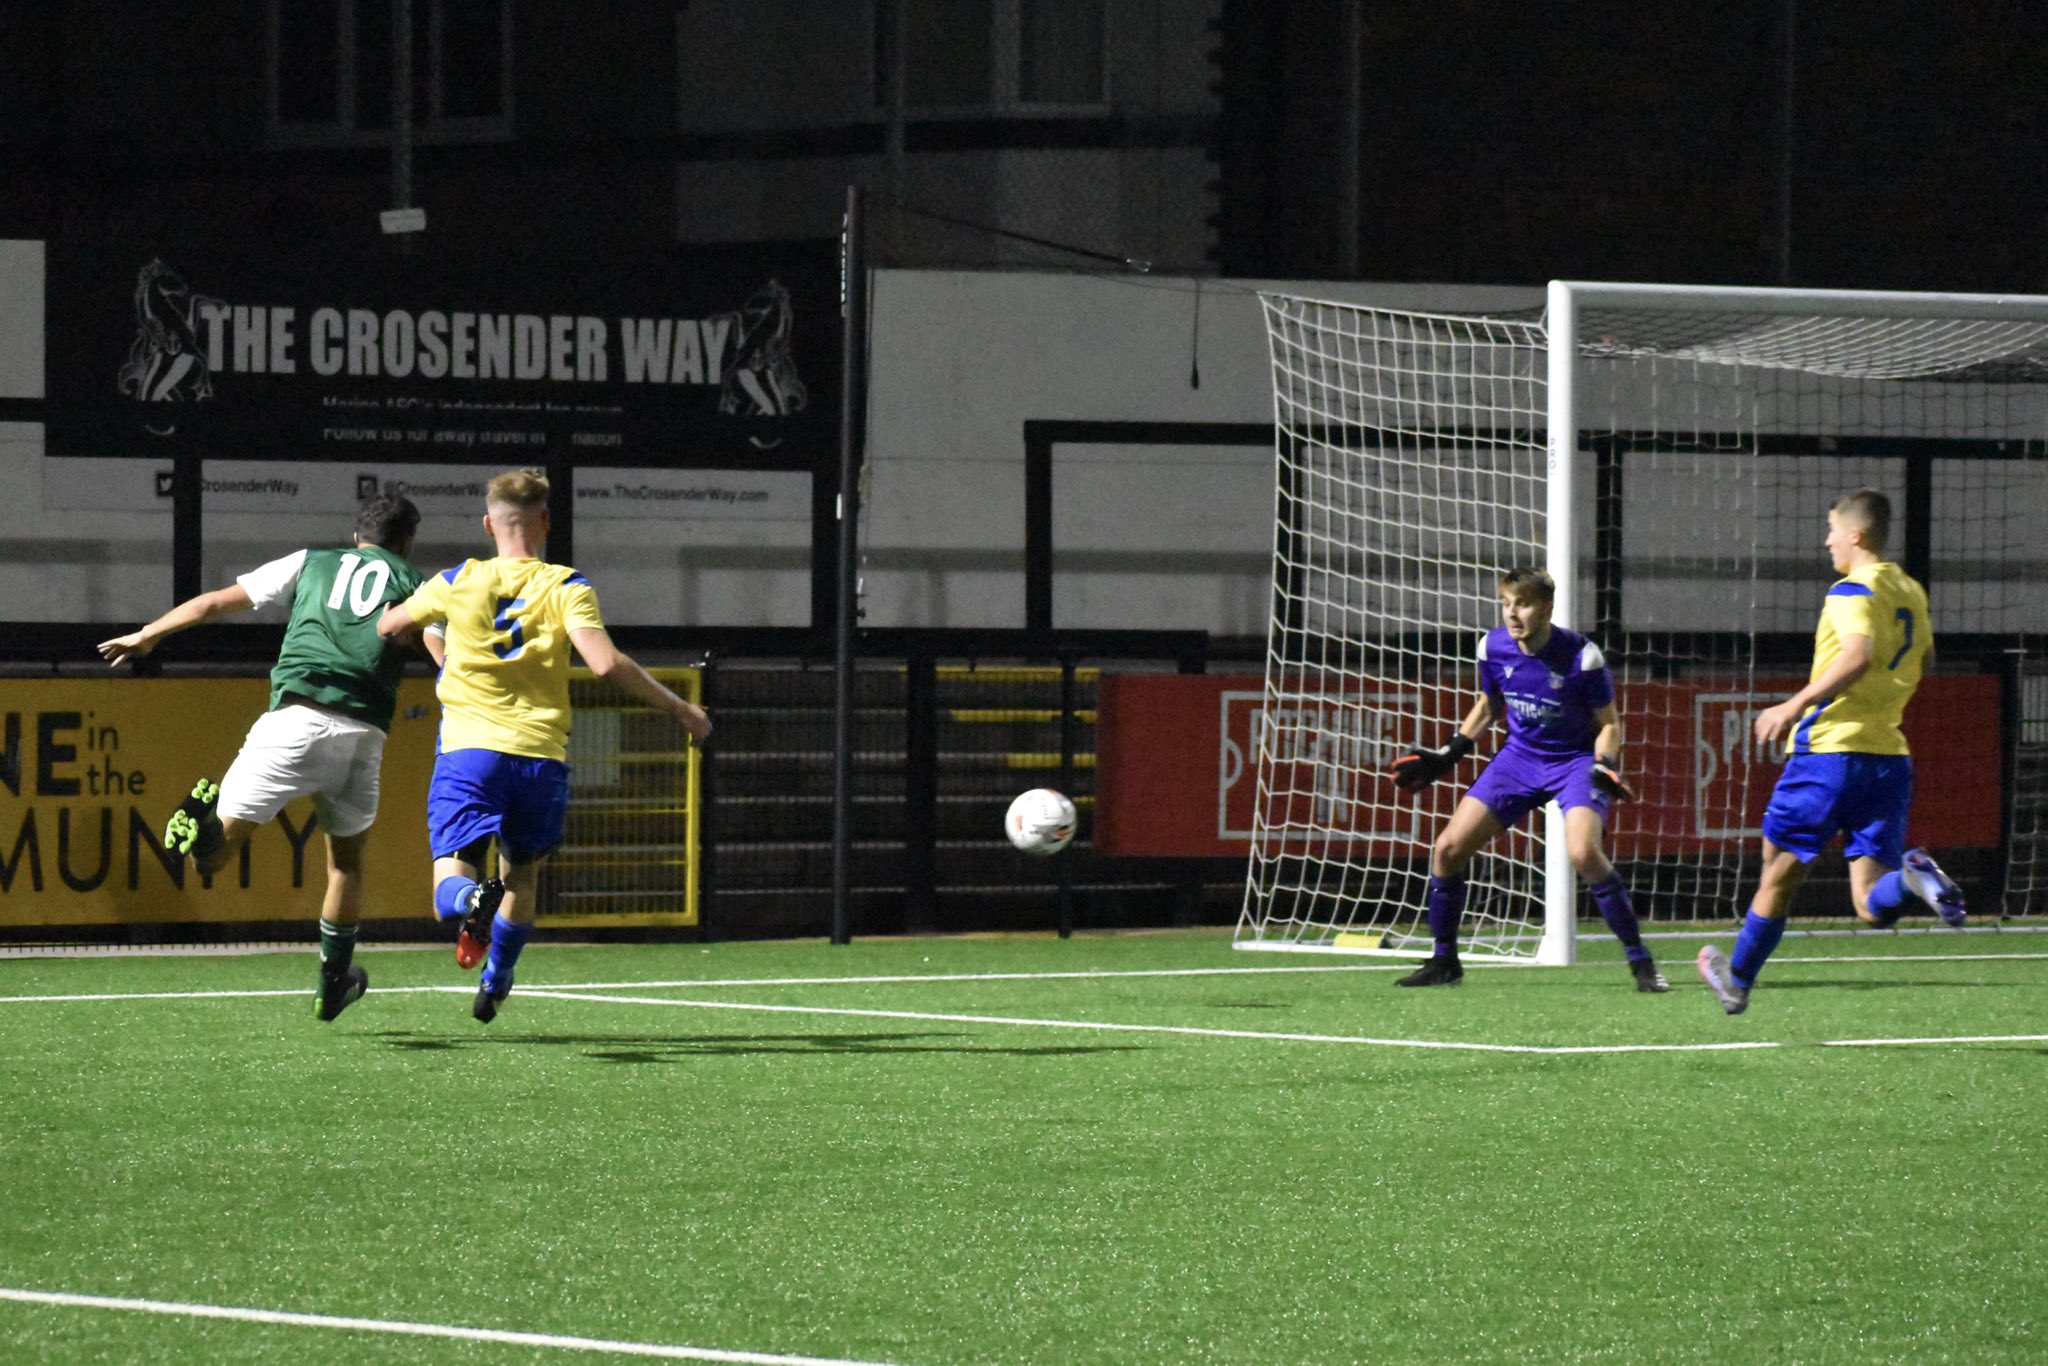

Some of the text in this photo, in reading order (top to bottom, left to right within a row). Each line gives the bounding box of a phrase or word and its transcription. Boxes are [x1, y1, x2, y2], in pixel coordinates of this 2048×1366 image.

[201, 305, 730, 384] THE CROSENDER WAY
[433, 431, 475, 447] away
[202, 477, 299, 497] rosenderWay
[575, 483, 769, 503] www.TheCrosenderWay.com
[327, 553, 390, 617] 10
[494, 597, 525, 660] 5
[1888, 606, 1914, 671] 7
[88, 711, 119, 751] in
[1249, 708, 1393, 766] PITCHING
[87, 755, 146, 796] the
[1317, 766, 1349, 823] IN
